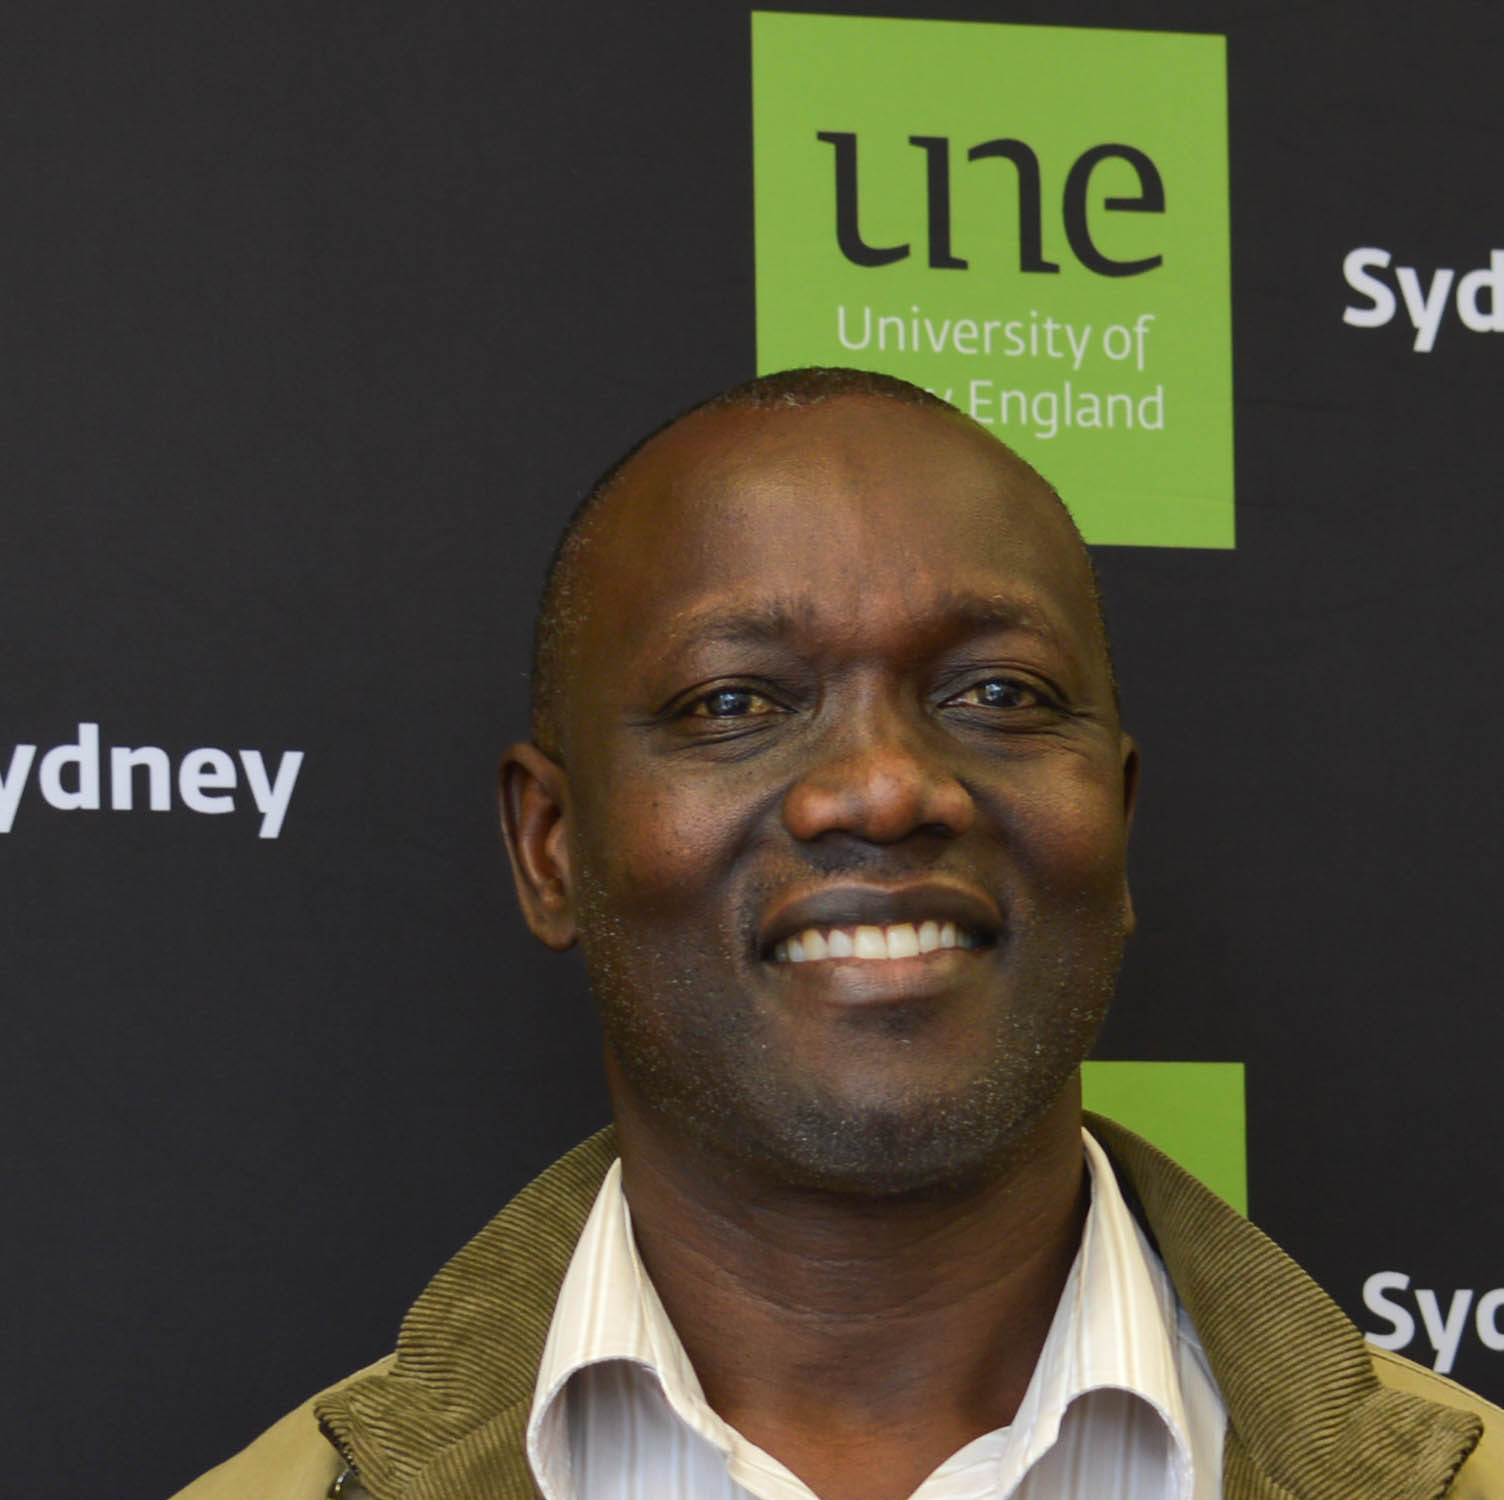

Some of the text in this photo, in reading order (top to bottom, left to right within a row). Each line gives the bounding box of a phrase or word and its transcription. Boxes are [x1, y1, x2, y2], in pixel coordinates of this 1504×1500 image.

[816, 130, 1166, 279] une
[836, 305, 1157, 372] University of
[968, 378, 1165, 440] England
